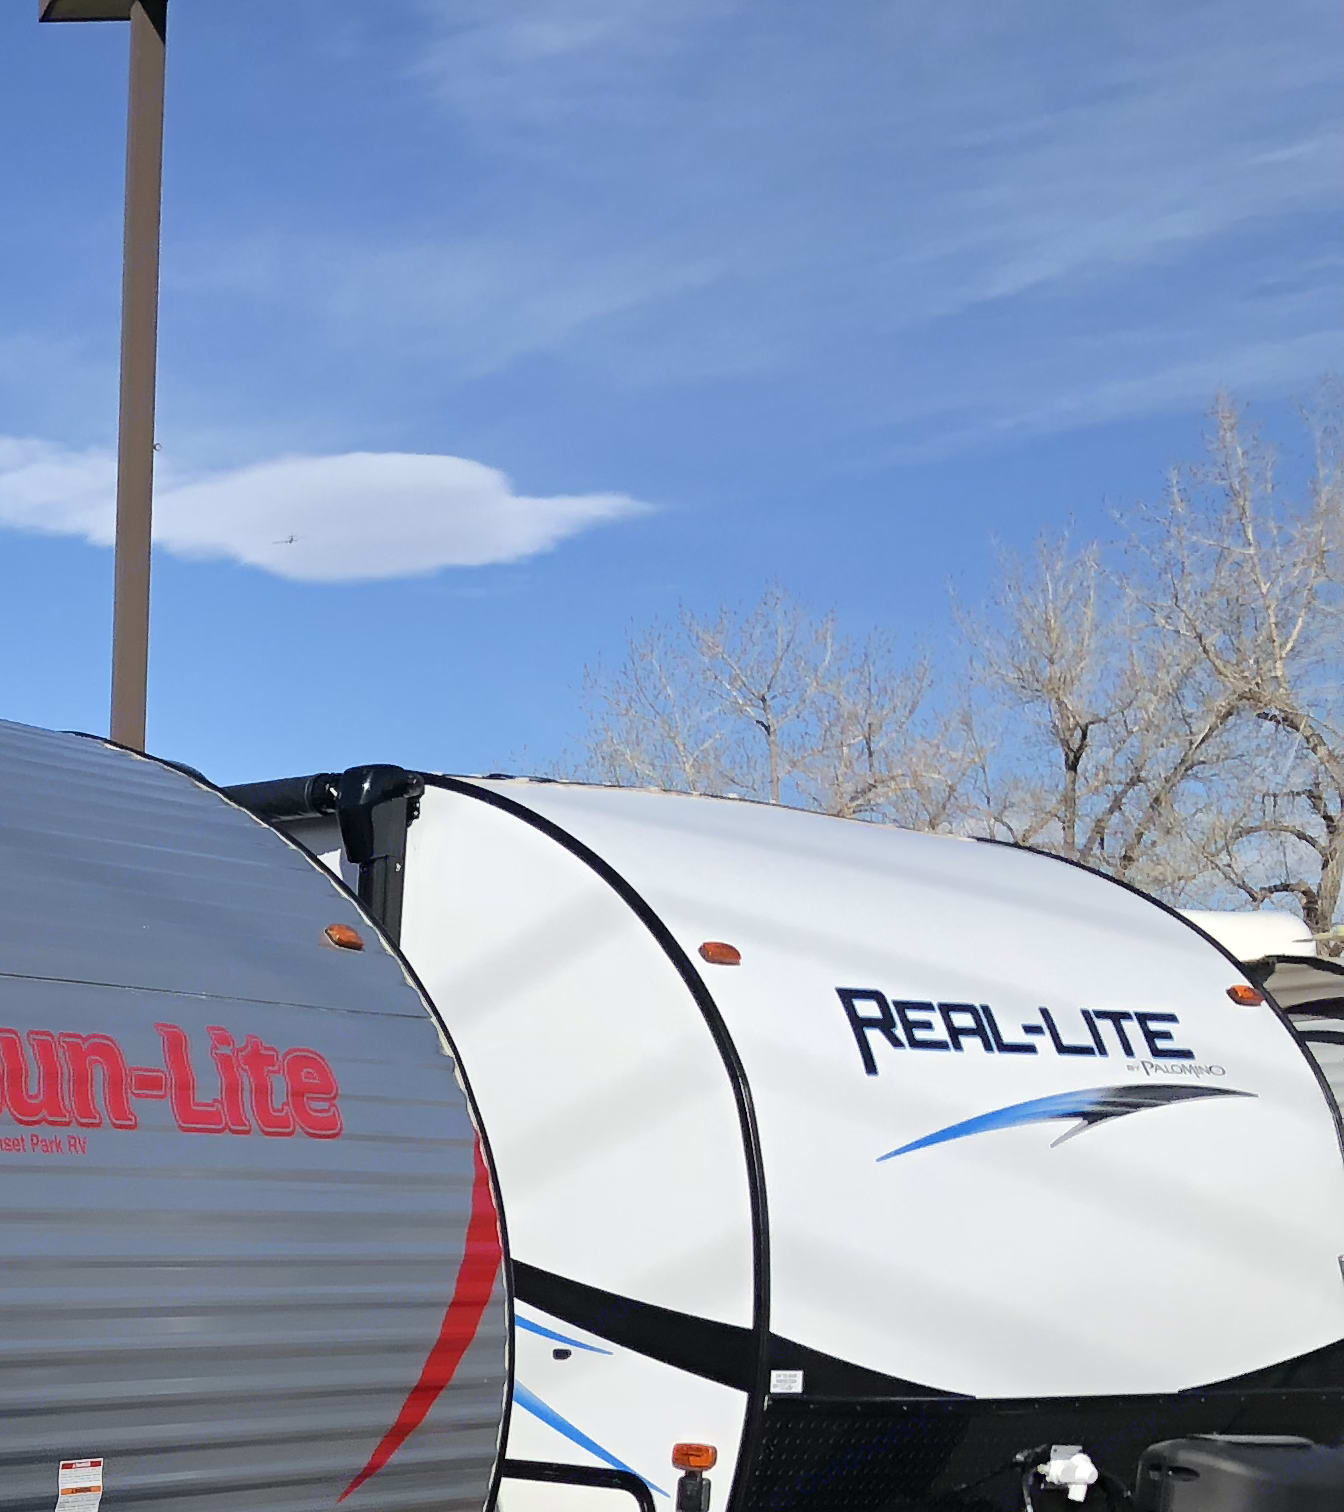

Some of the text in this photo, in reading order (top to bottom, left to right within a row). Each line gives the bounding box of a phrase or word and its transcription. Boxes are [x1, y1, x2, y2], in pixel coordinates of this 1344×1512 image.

[835, 987, 1195, 1077] REAL-LITE
[29, 1133, 65, 1155] Park
[67, 1134, 89, 1155] RV
